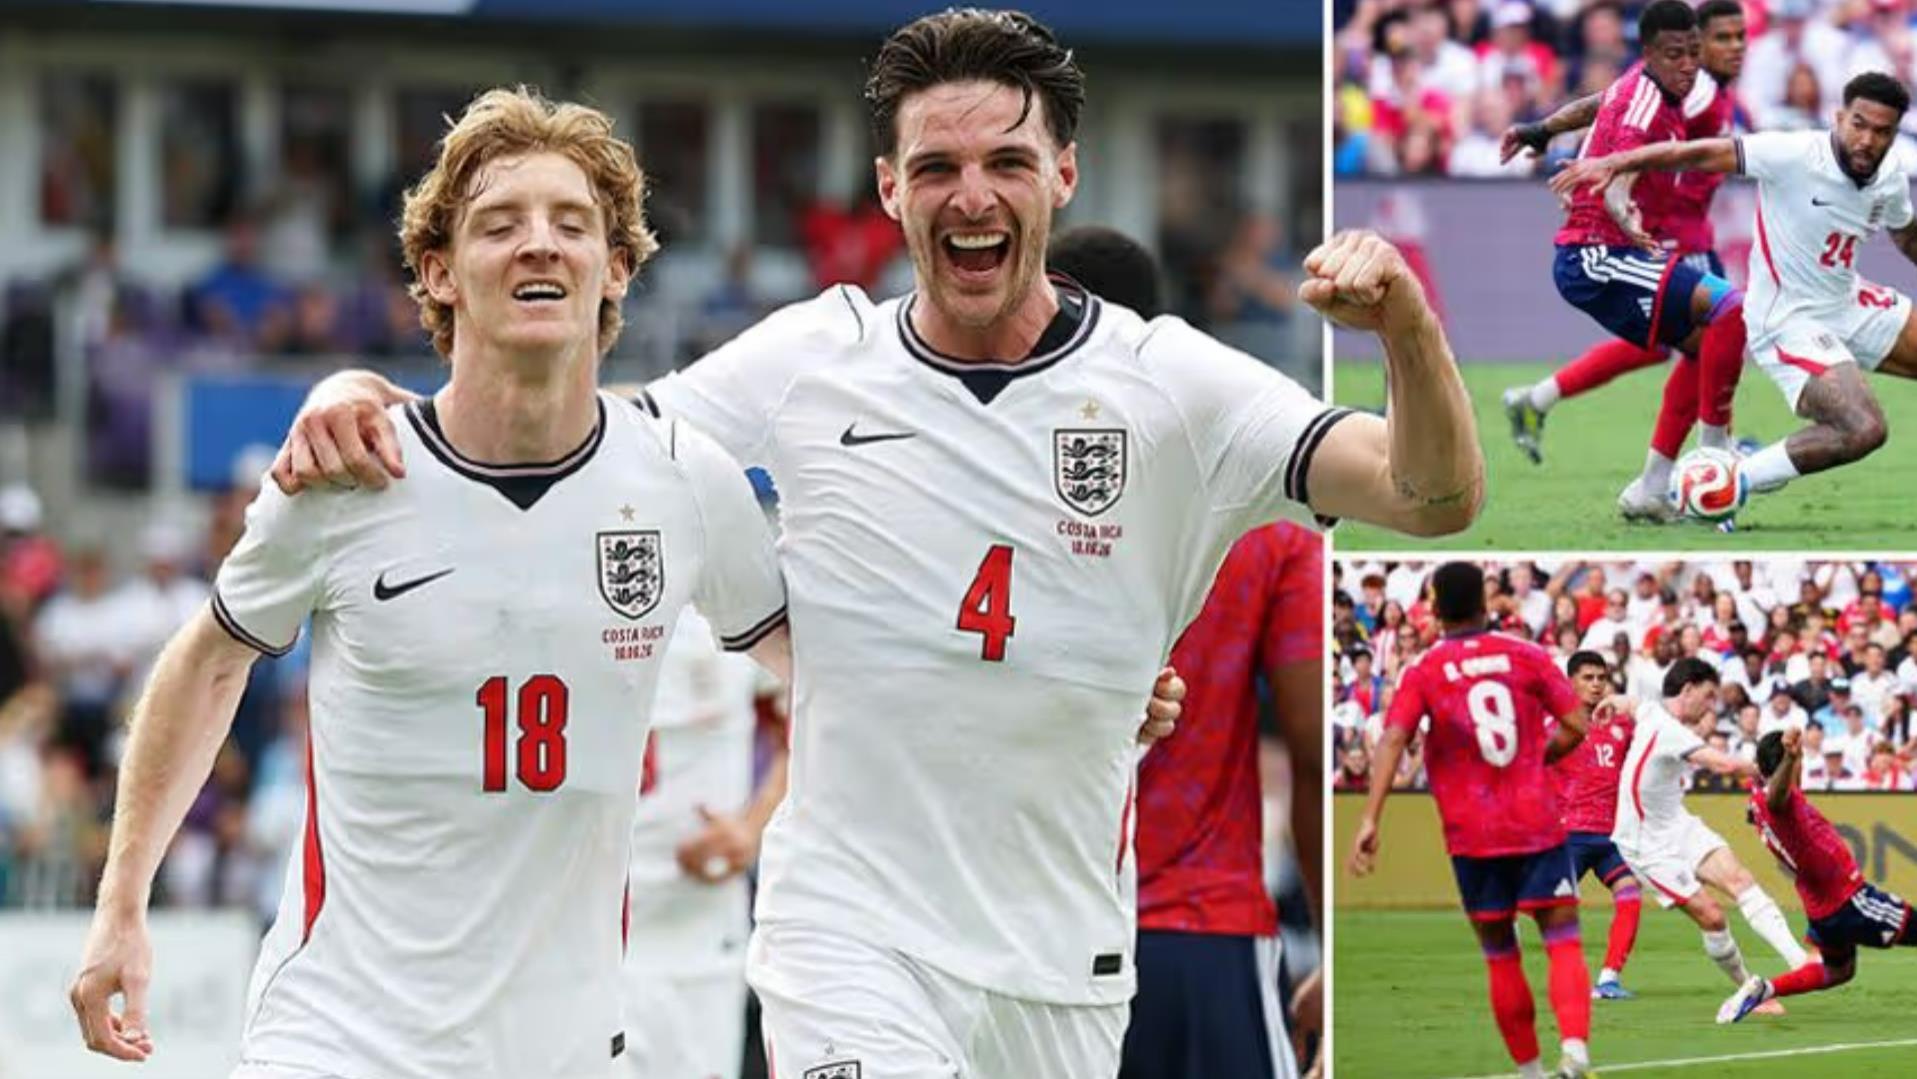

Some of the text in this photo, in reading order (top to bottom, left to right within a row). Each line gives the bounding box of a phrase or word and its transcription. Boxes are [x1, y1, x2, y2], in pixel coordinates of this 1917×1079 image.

[1820, 231, 1858, 269] 24
[1057, 520, 1096, 539] COSTA
[956, 544, 1016, 661] 4
[602, 627, 639, 643] COSTA
[476, 674, 569, 793] 18
[1467, 680, 1519, 769] 8
[1594, 743, 1616, 768] 12
